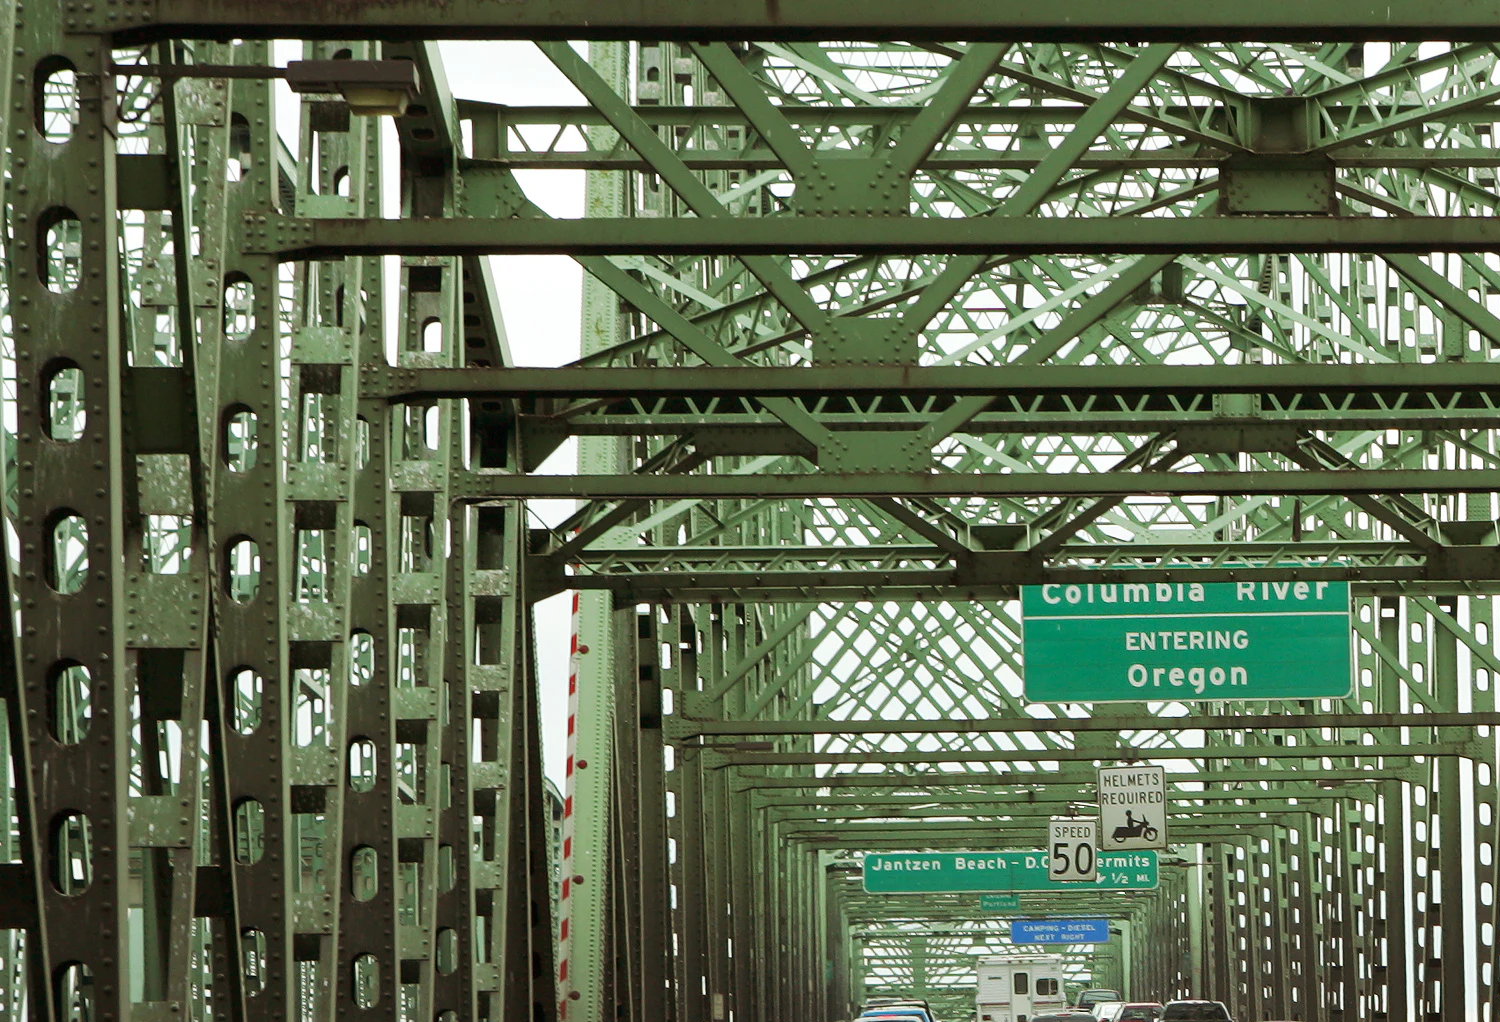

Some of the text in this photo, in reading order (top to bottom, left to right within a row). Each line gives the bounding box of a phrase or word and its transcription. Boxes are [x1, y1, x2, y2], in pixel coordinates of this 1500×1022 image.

[1041, 581, 1330, 605] Columbia River
[1125, 630, 1249, 651] ENTERING
[1127, 664, 1249, 694] Oregon
[1103, 773, 1159, 787] HELMETS
[1101, 791, 1163, 805] REQUIRED
[1054, 826, 1091, 838] SPEED
[872, 858, 941, 871] Jantzen
[1096, 854, 1150, 868] ermits
[1053, 842, 1093, 875] 50
[1067, 924, 1096, 932] DIESEL
[1061, 933, 1085, 941] RIGHT
